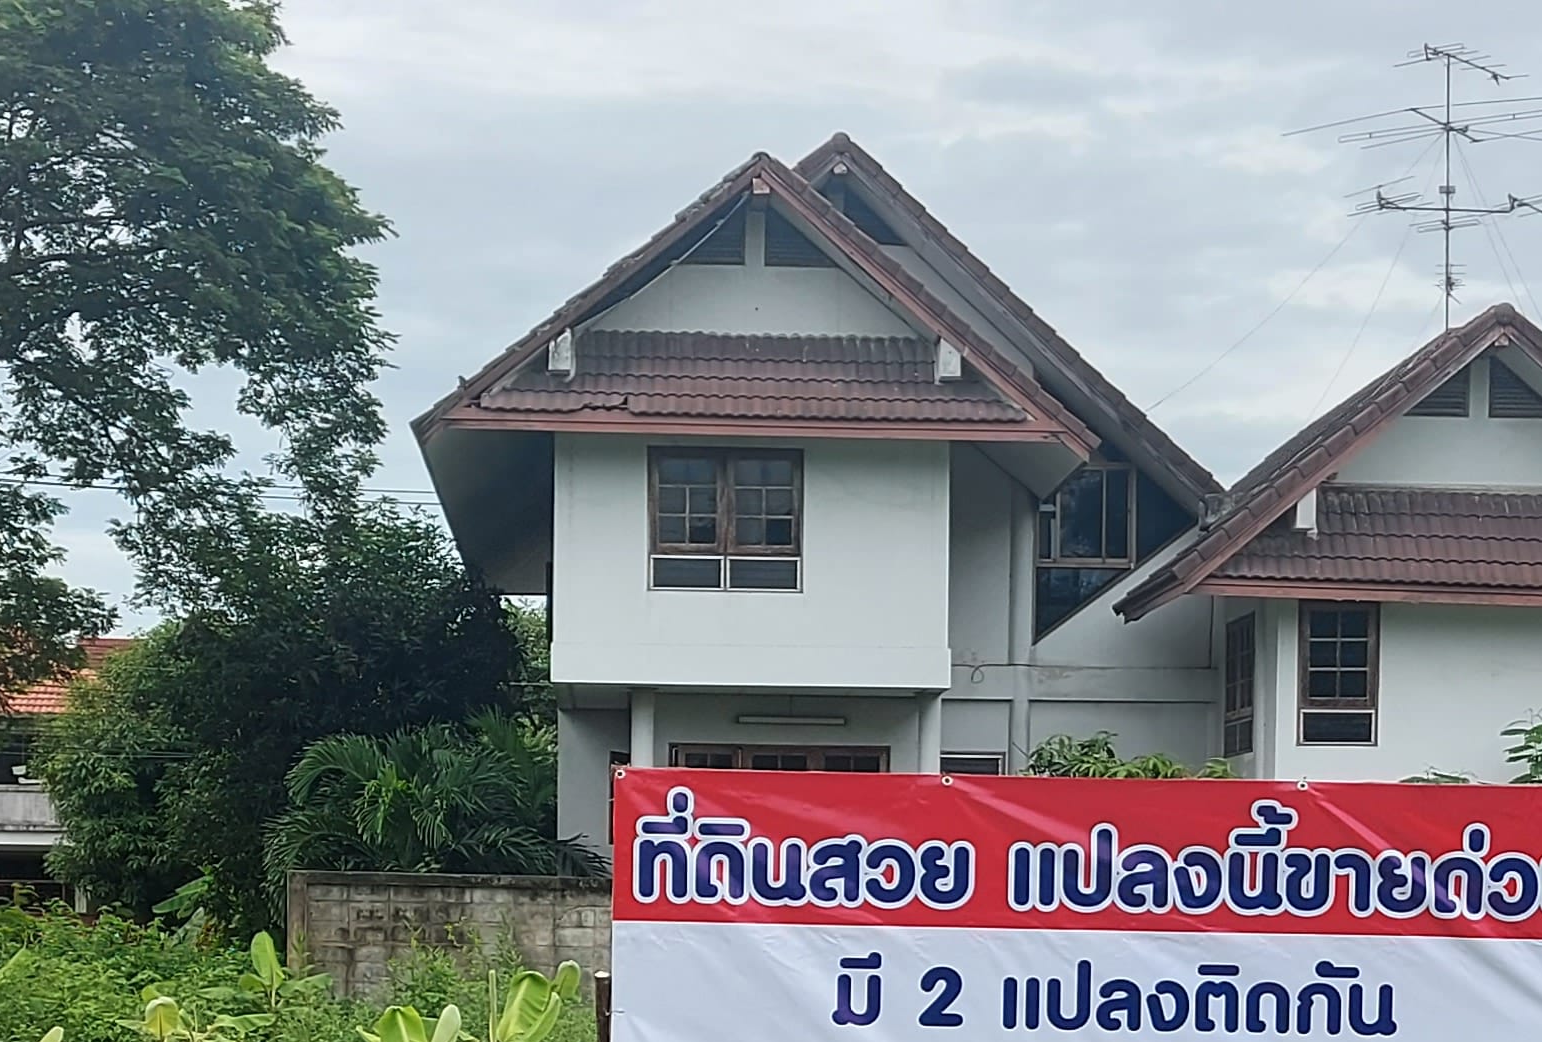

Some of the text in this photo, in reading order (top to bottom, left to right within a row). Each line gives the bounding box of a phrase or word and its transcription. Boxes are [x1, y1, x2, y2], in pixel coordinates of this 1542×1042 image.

[634, 787, 975, 910] ที่ดินสวย
[832, 952, 1397, 1035] มี 2 แปลงติดกัน
